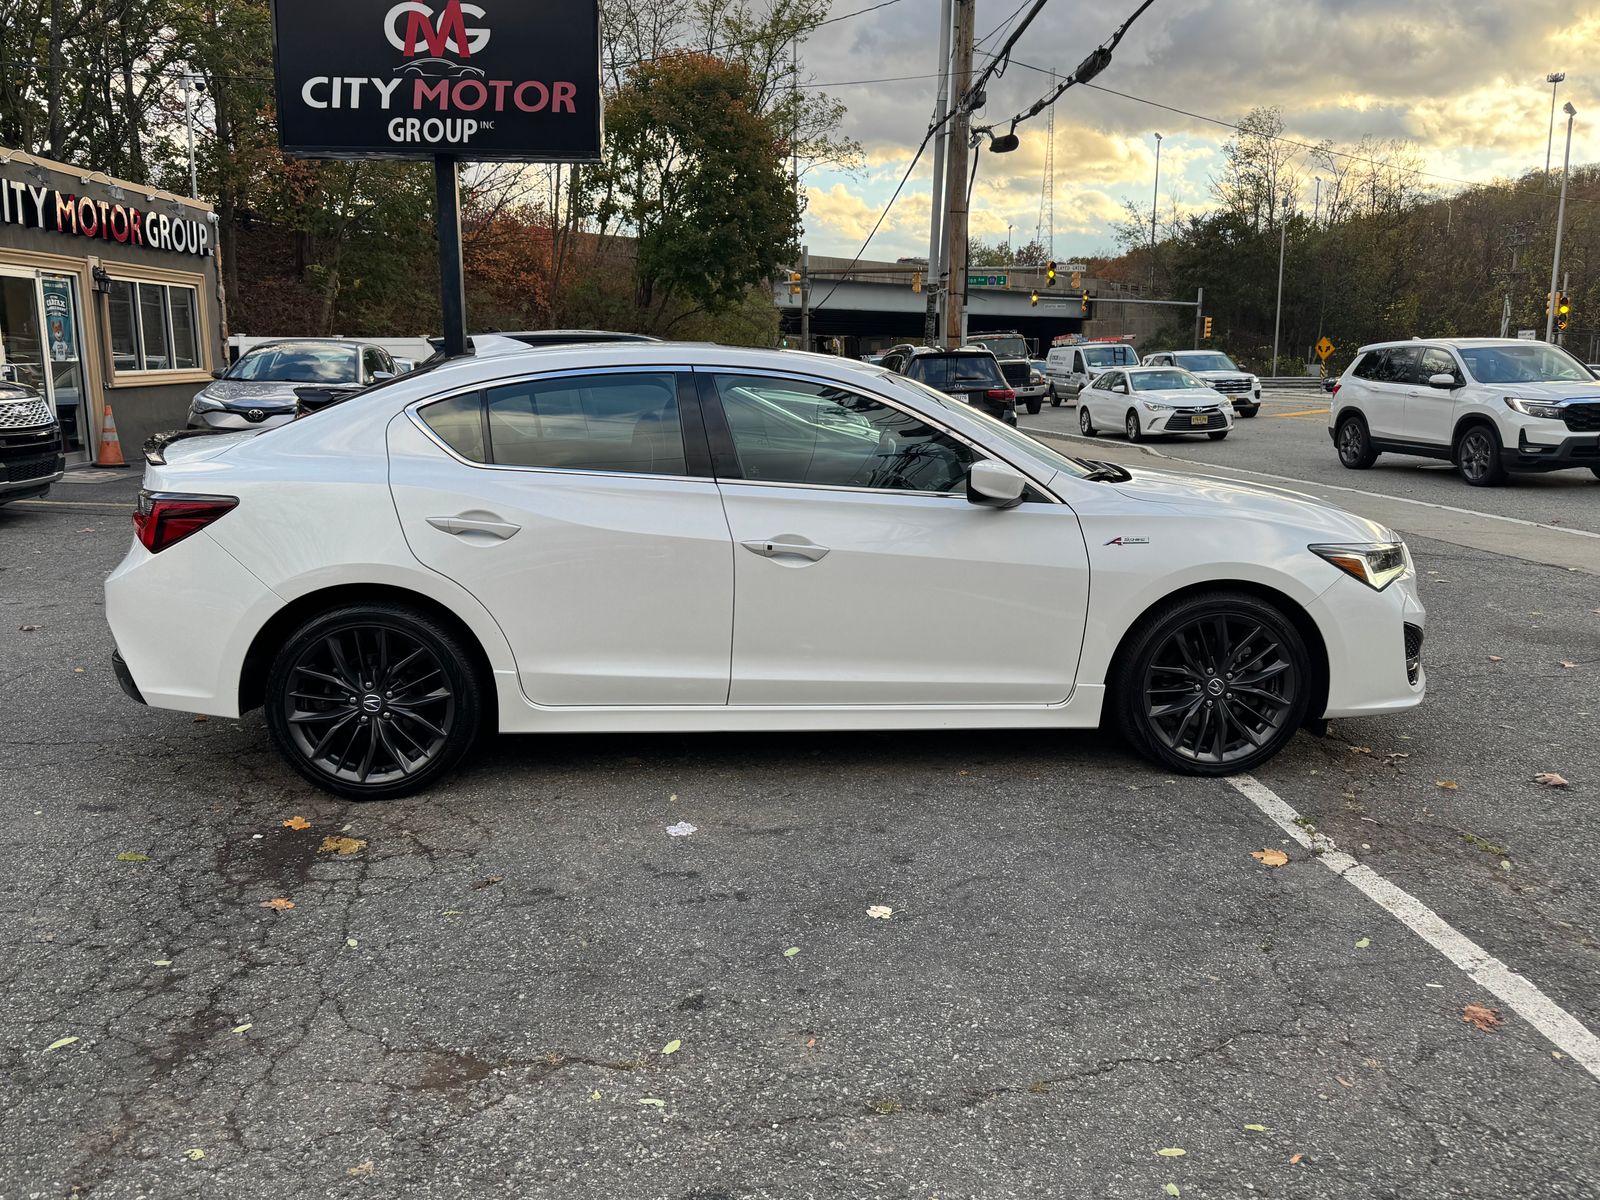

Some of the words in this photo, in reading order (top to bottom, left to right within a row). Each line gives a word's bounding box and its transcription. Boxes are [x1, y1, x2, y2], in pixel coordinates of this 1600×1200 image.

[301, 76, 403, 109] CITY
[413, 79, 577, 113] MOTOR
[387, 117, 478, 143] GROUP
[480, 120, 495, 130] INC
[1, 178, 48, 228] ITY
[55, 190, 144, 246] MOTOR
[145, 211, 208, 256] GROUP
